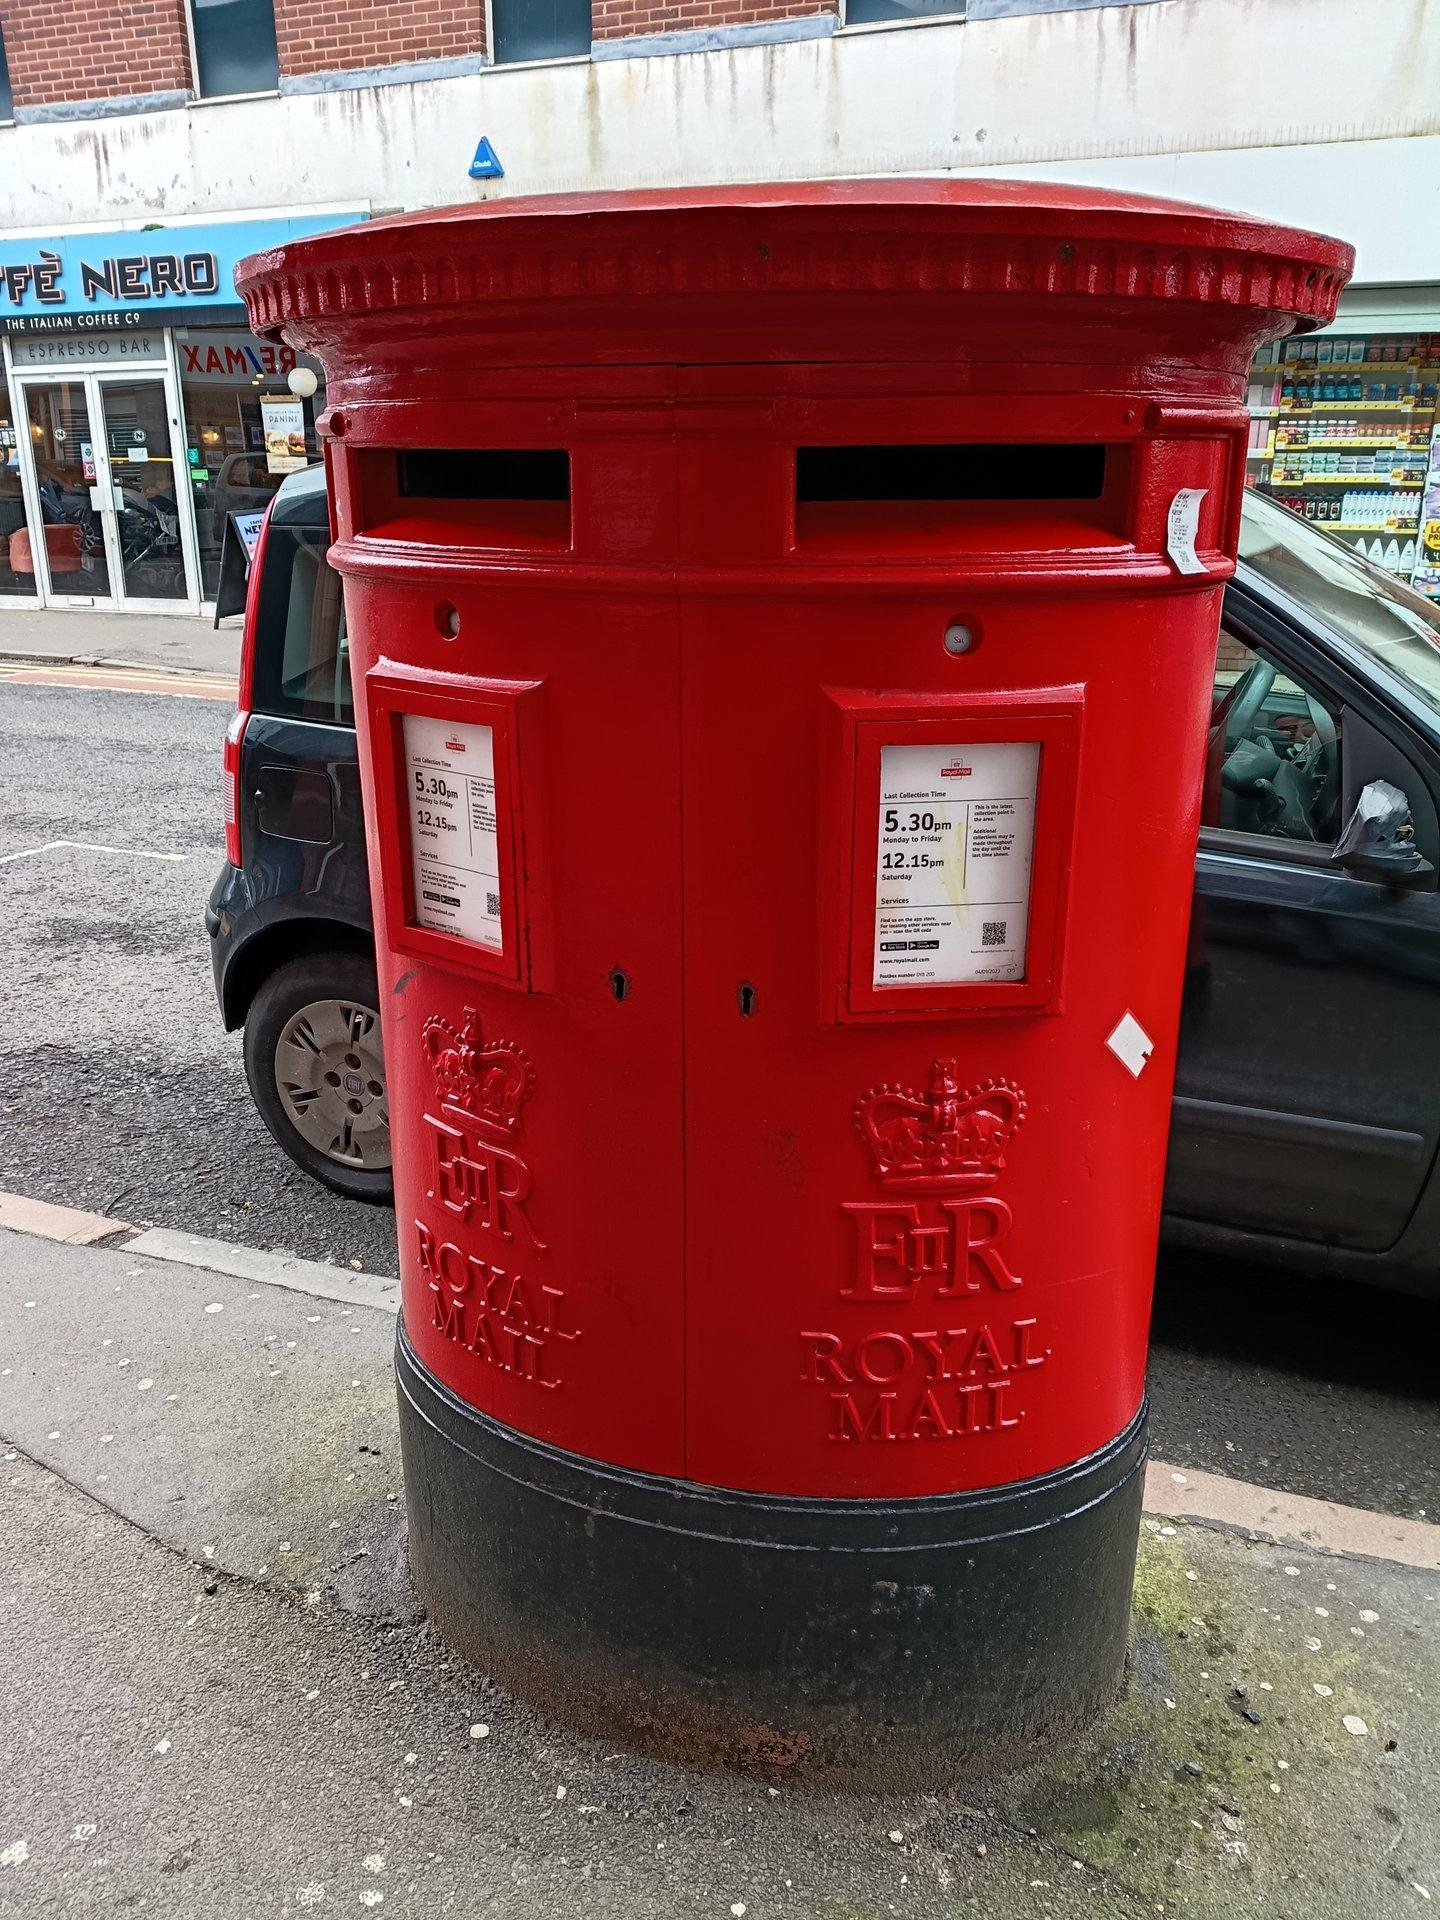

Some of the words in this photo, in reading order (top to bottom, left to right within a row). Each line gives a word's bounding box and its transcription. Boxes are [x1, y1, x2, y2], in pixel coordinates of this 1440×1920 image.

[0, 250, 65, 305] FÈ
[80, 253, 219, 301] NERO
[6, 319, 25, 330] THE
[30, 316, 72, 328] ITALIAN
[78, 313, 120, 326] COFFEE
[29, 340, 109, 358] ESPRESSO
[120, 338, 150, 354] BAR
[415, 772, 458, 799] 5.30pm
[416, 795, 432, 804] Monday
[440, 800, 453, 809] Friday
[417, 810, 458, 832] 12.15pm
[884, 810, 952, 832] 5.30pm
[418, 828, 438, 839] Saturday
[882, 836, 910, 844] Monday
[420, 850, 438, 860] Services
[882, 852, 944, 869] 12.15pm
[880, 897, 910, 905] Services
[414, 1218, 582, 1340] ROYAL
[428, 1281, 562, 1388] MAIL
[800, 1318, 1052, 1384] ROYAL
[828, 1380, 1026, 1441] MAIL
